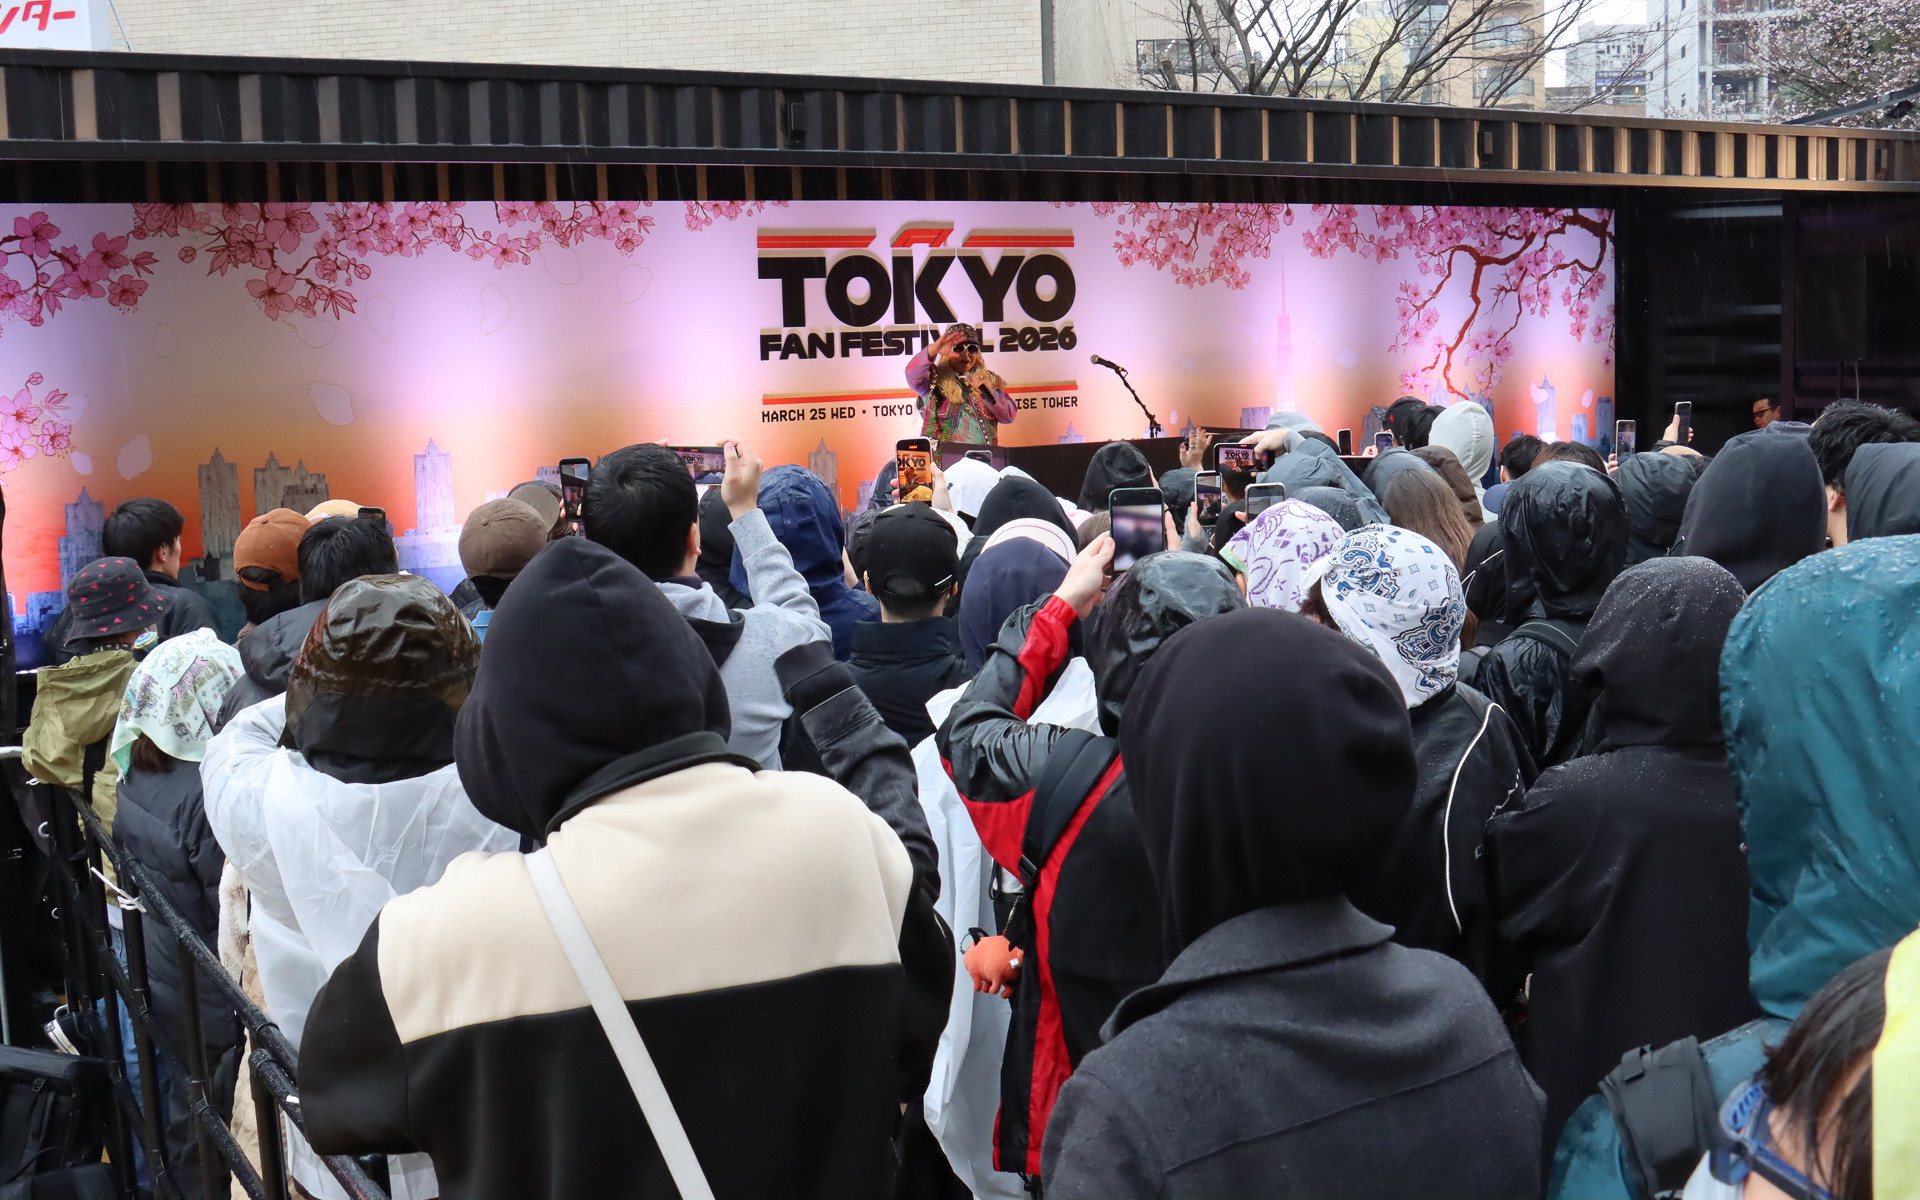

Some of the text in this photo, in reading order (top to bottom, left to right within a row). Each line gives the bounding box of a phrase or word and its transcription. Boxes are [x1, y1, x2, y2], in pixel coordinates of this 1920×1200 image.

[758, 254, 1076, 327] TOKYO
[760, 326, 1077, 361] FAN FESTIL 2026
[762, 409, 805, 423] MARCH
[809, 408, 826, 420] 25
[831, 406, 856, 419] WED
[873, 404, 913, 417] TOKYO
[1041, 396, 1078, 409] TOWER
